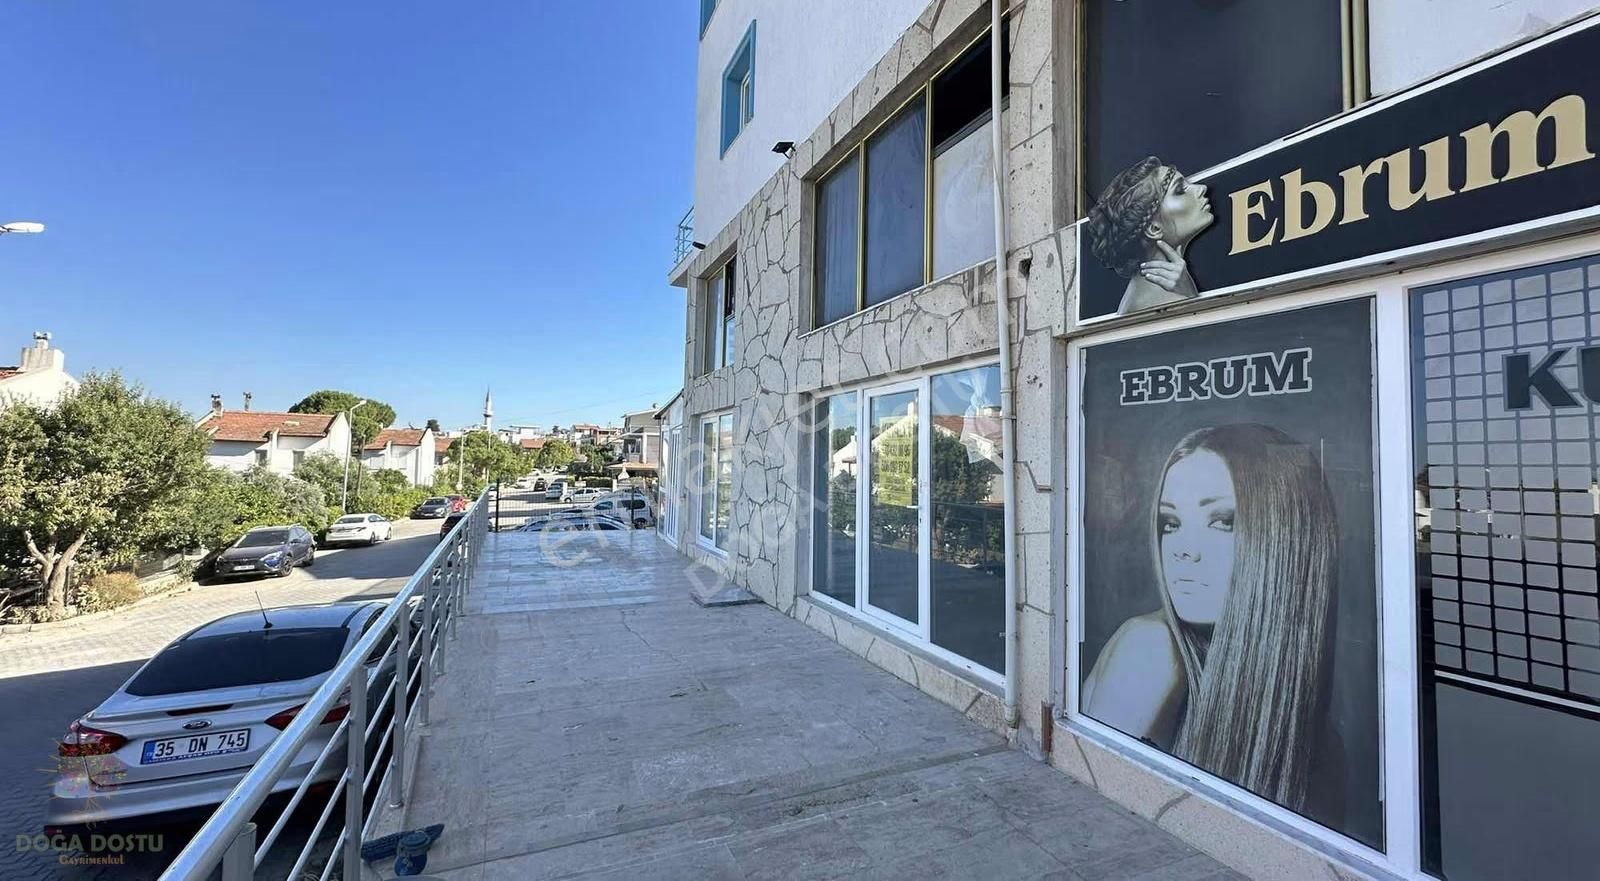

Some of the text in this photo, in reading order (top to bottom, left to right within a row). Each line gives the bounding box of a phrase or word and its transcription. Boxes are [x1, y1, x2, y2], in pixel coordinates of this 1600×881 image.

[1228, 94, 1596, 256] Ebrum
[1120, 347, 1312, 405] EBRUM
[155, 741, 175, 757] 35
[188, 737, 208, 753] DN
[217, 732, 246, 749] 745
